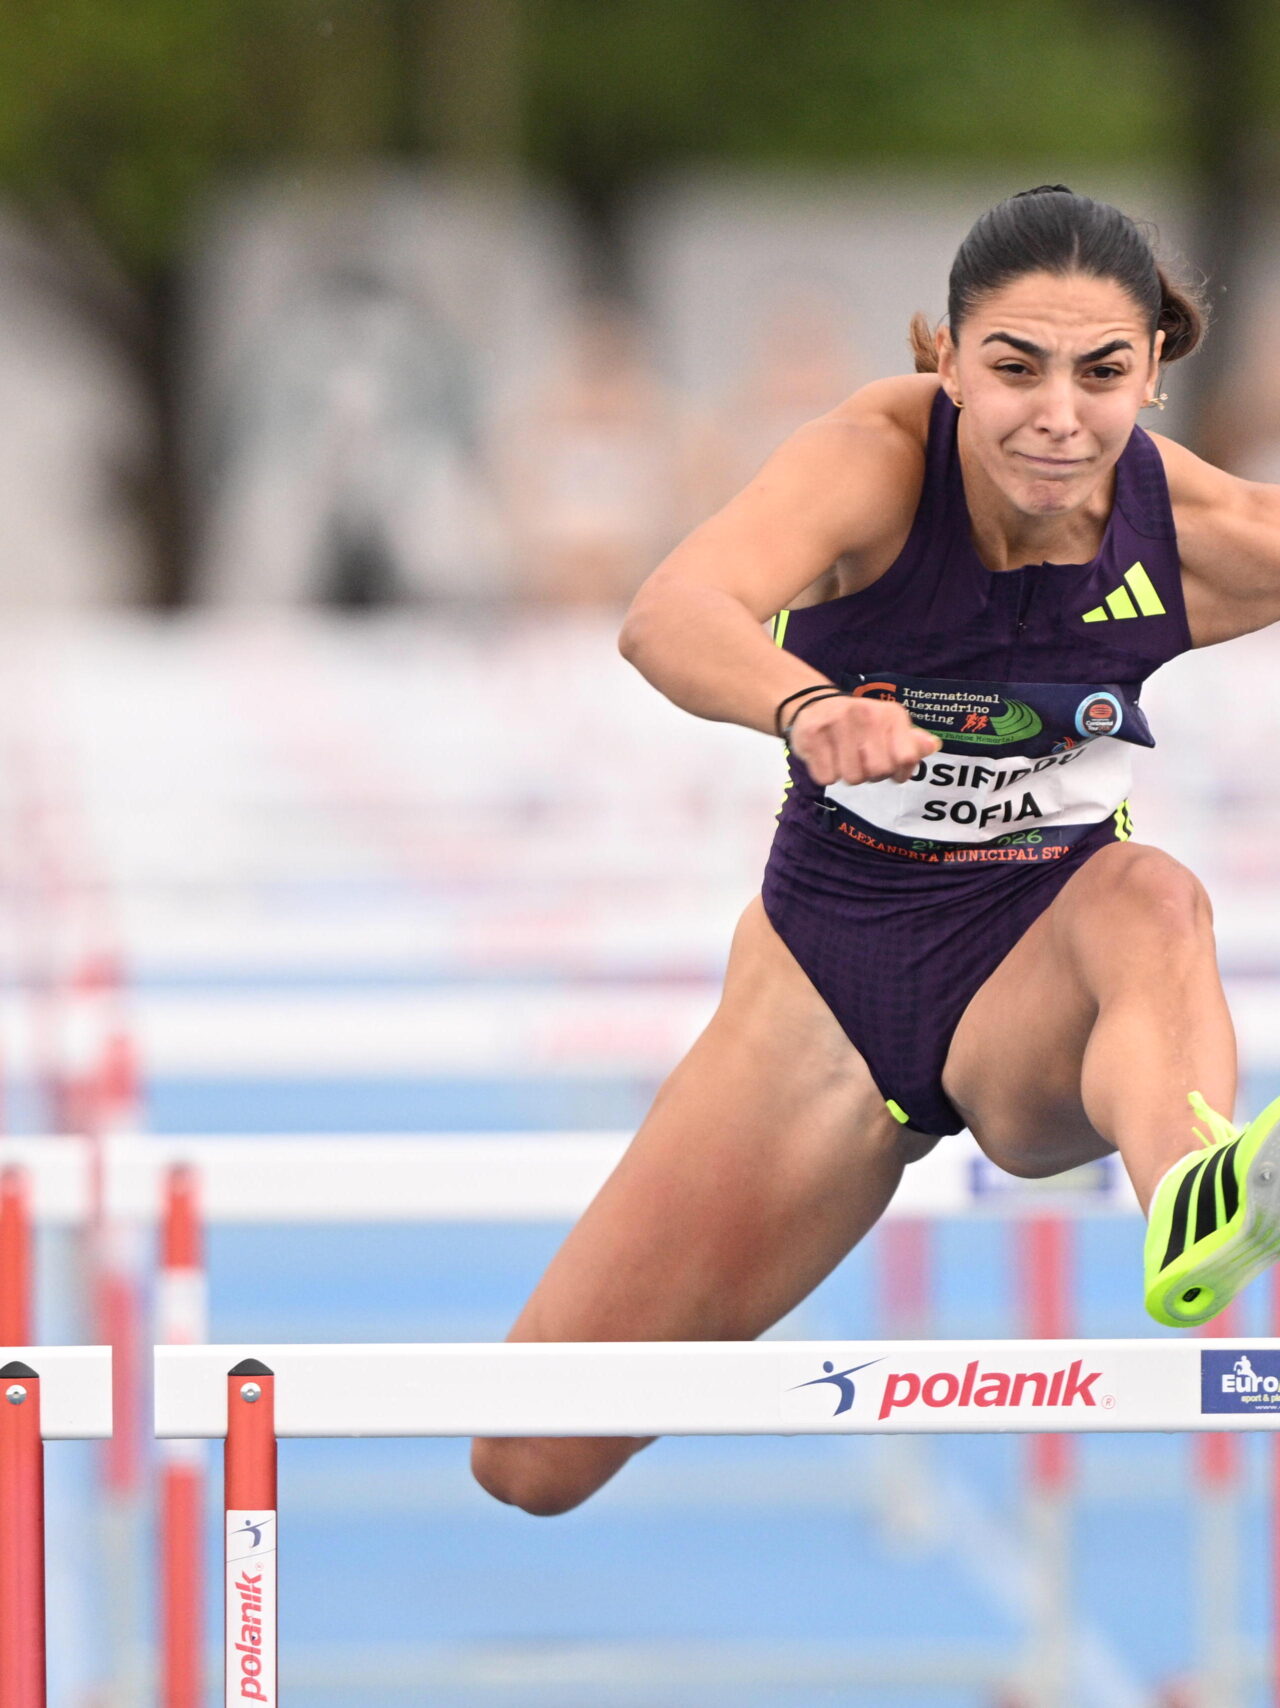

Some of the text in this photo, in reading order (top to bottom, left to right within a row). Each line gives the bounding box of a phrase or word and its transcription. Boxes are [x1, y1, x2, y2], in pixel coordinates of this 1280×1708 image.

[902, 688, 1000, 704] International
[902, 699, 990, 714] Alexandrino
[905, 709, 955, 725] eeting
[910, 747, 1087, 792] OSIFIDOU
[921, 791, 1043, 829] SOFIA
[838, 822, 939, 862] ALEXANDRIA
[943, 847, 1039, 863] MUNICIPAL
[878, 1358, 1103, 1421] polanik
[1241, 1394, 1261, 1404] sport
[1263, 1394, 1270, 1402] &
